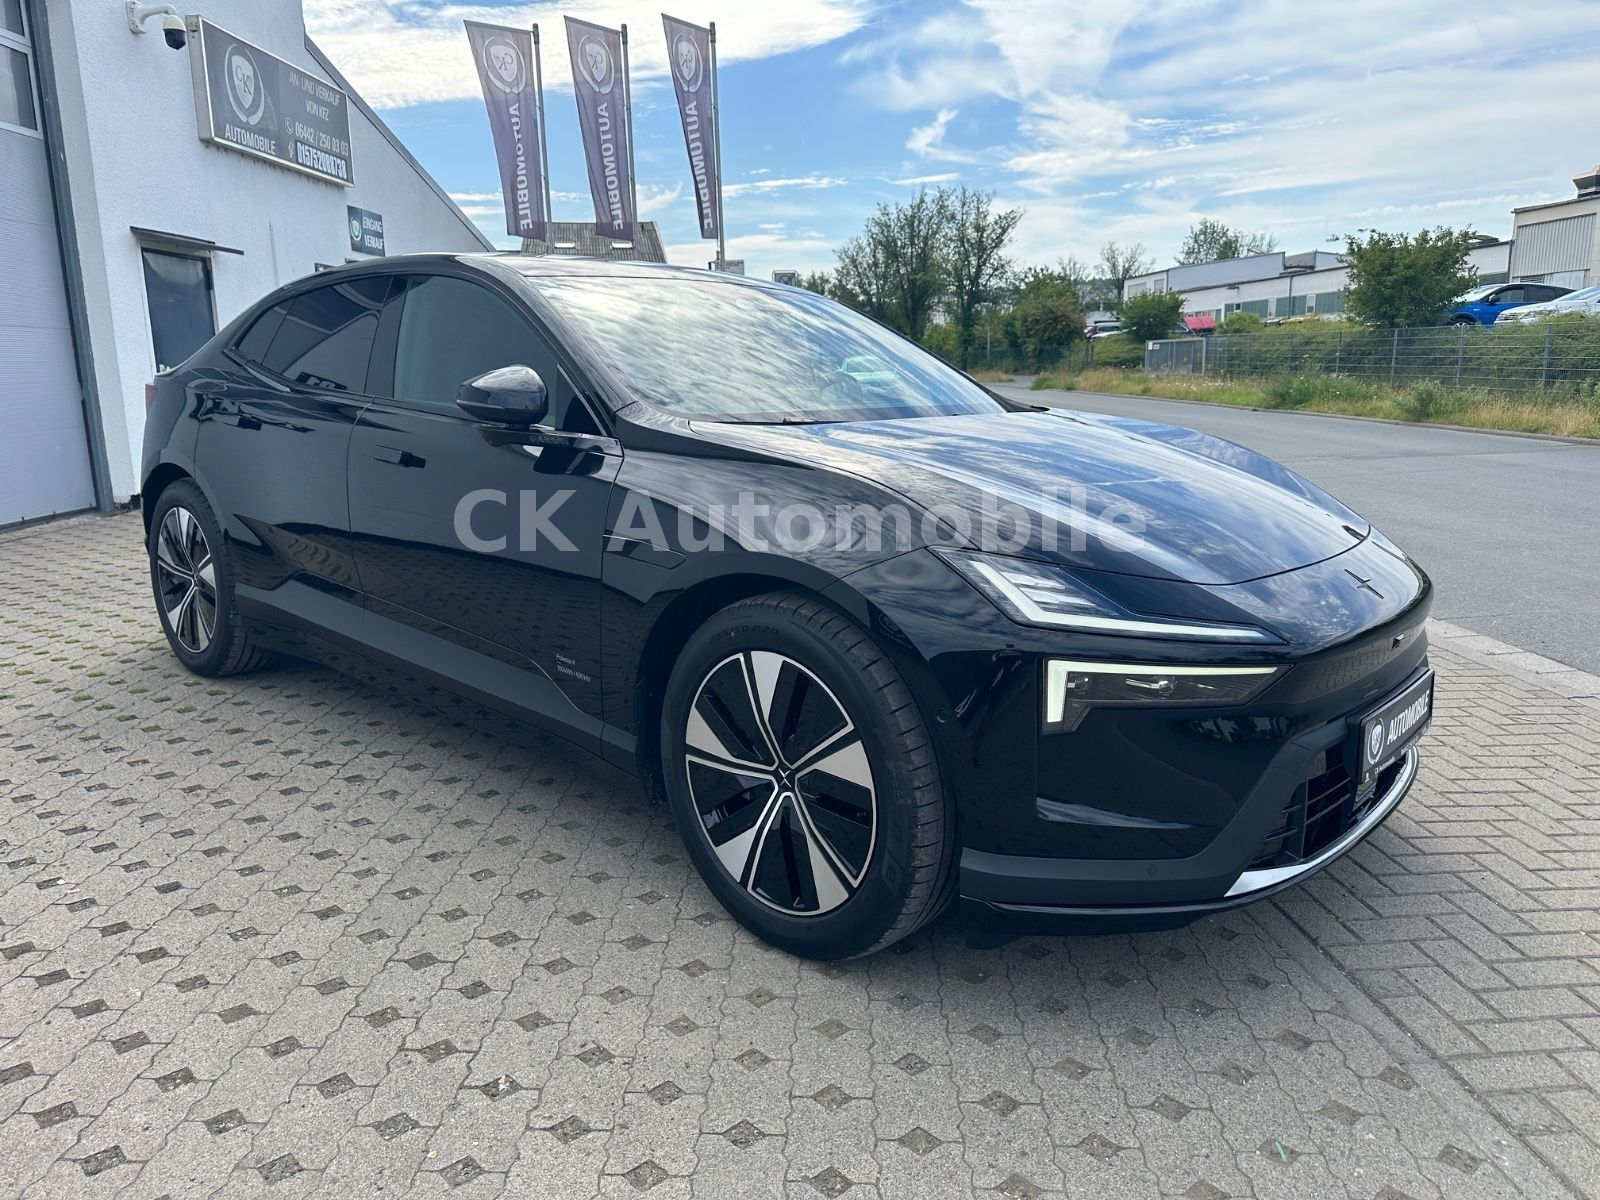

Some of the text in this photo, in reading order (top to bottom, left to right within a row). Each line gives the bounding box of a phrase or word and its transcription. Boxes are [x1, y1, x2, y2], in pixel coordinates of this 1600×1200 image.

[315, 83, 340, 107] VERKAUF
[224, 123, 276, 156] AUTOMOBILE
[1386, 689, 1430, 746] AUTOMOBILE
